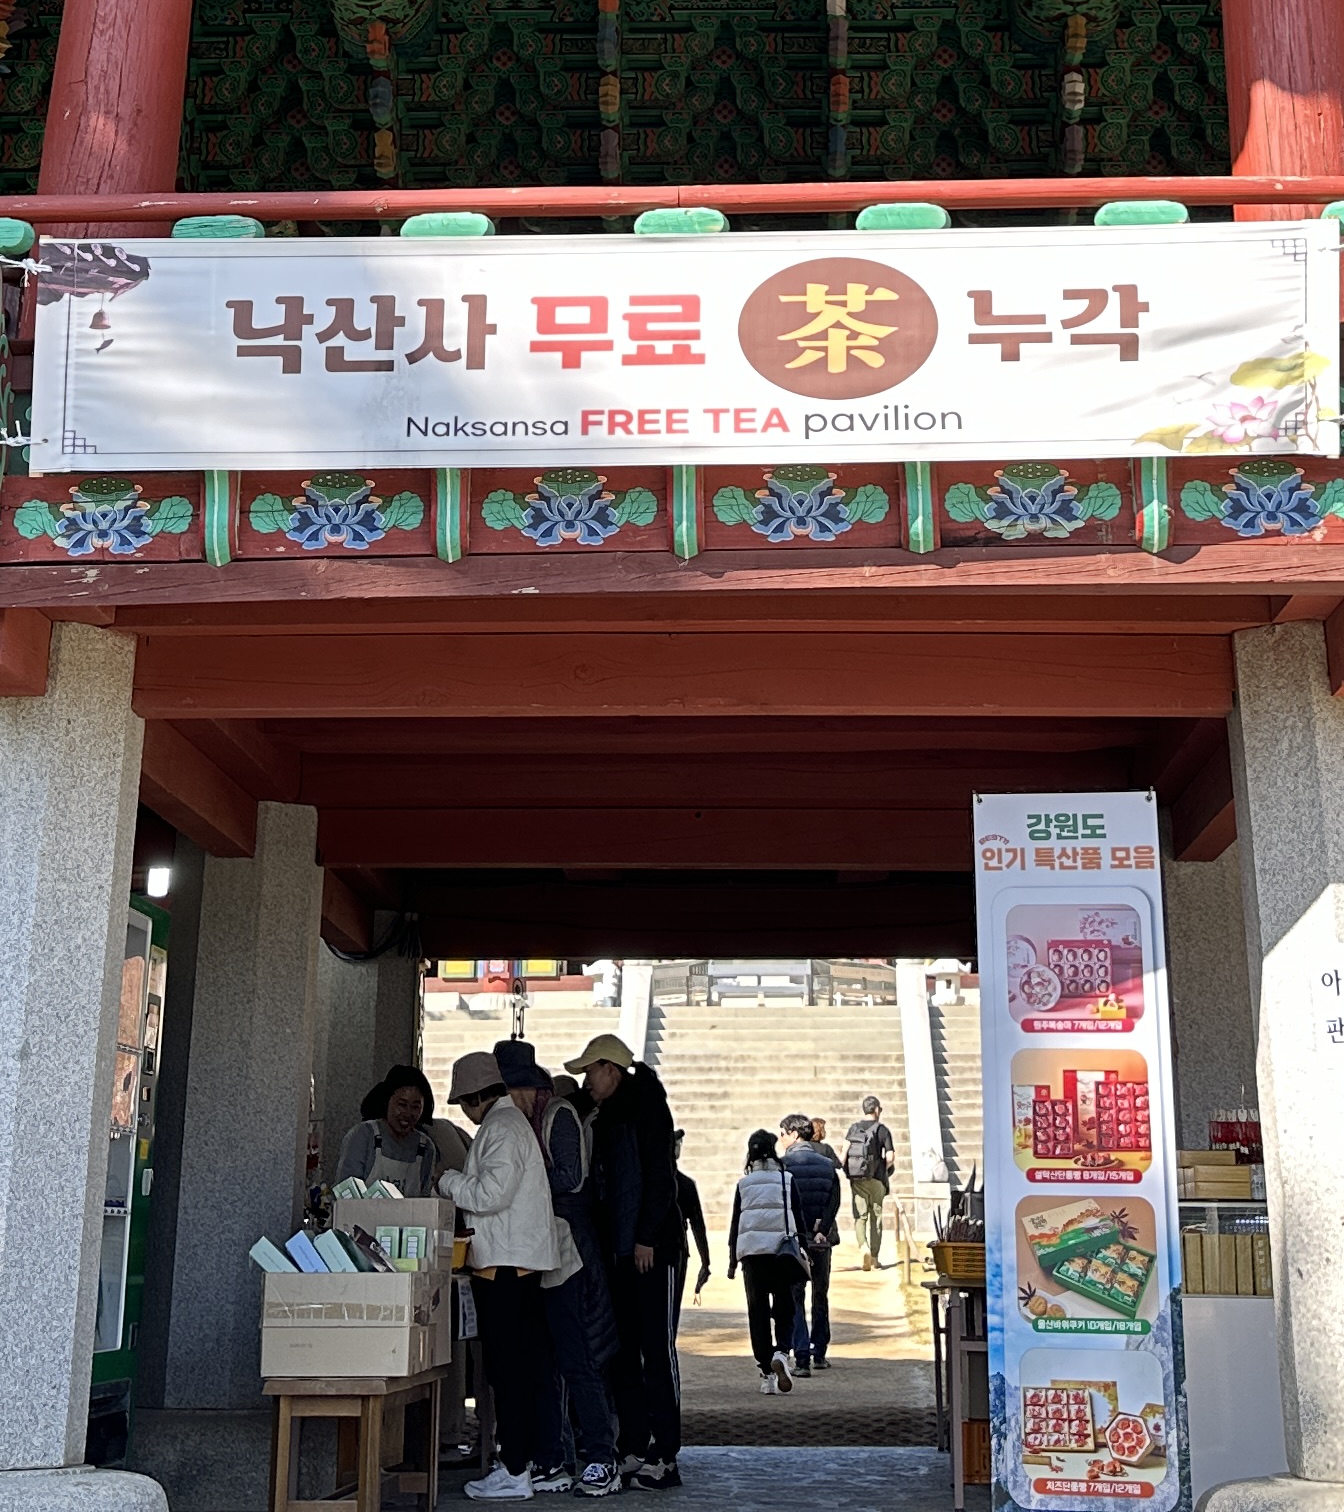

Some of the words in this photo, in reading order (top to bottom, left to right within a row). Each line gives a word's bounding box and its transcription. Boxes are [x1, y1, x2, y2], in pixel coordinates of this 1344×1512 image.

[225, 293, 496, 376] 낙산사
[529, 294, 706, 370] 무료
[775, 282, 897, 372] 茶
[965, 283, 1150, 364] 누각
[405, 412, 570, 439] Naksansa
[580, 408, 694, 437] FREE
[704, 407, 791, 434] TEA
[803, 402, 964, 441] pavilion
[1027, 812, 1107, 841] 강원도
[981, 847, 1026, 871] 인기
[1034, 846, 1102, 871] 특산품
[1109, 844, 1156, 870] 모음
